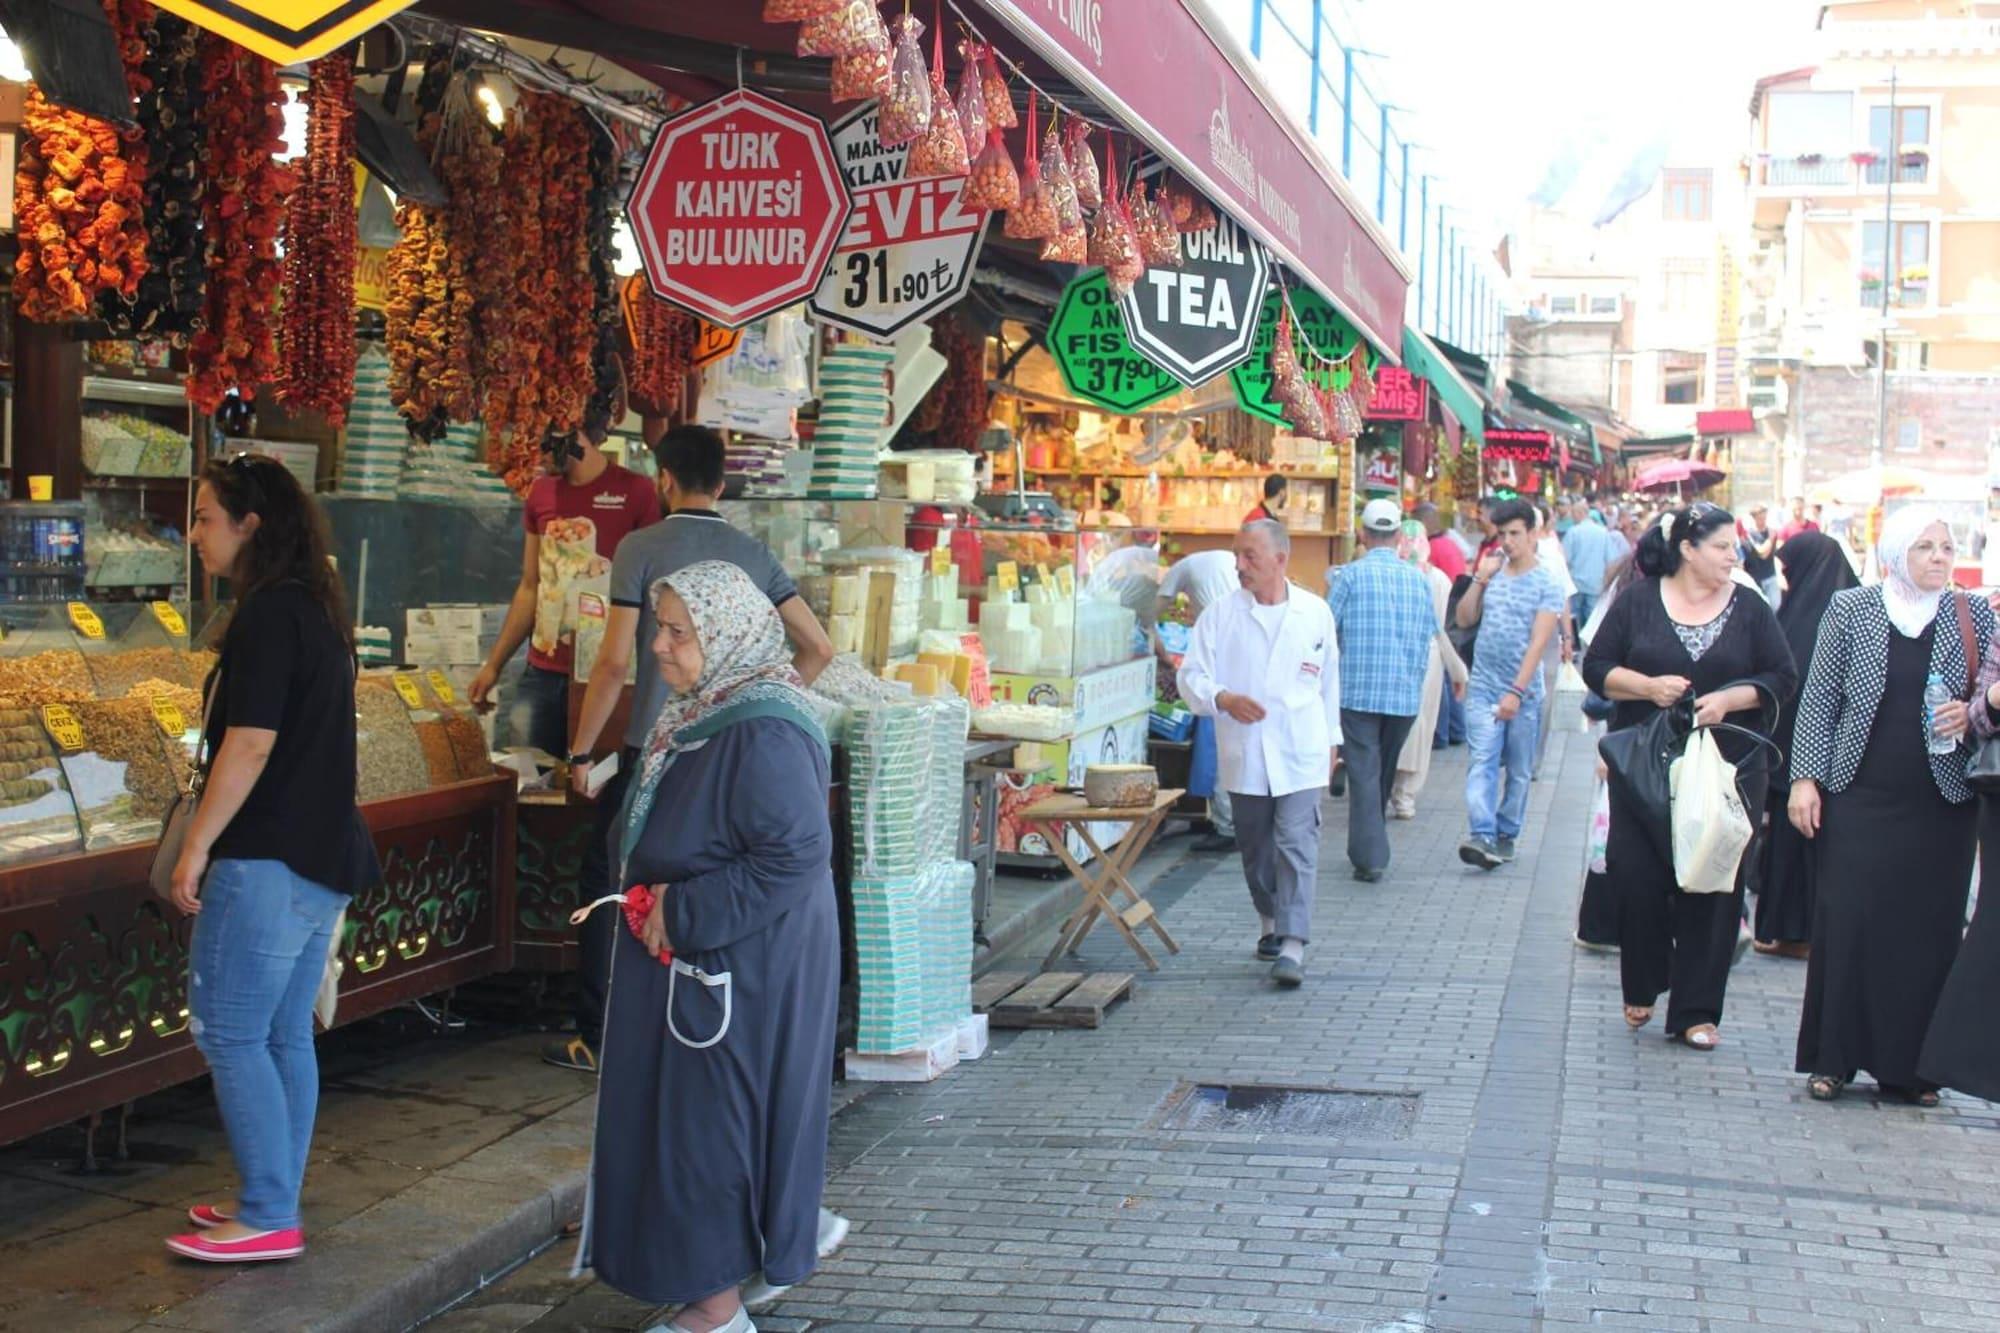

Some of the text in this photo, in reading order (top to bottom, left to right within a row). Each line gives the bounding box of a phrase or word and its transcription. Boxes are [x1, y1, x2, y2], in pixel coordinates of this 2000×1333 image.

[701, 123, 780, 170] TÜRK
[675, 169, 803, 218] KAHVESİ
[666, 227, 807, 266] BULUNUR
[1177, 212, 1245, 266] URAL
[1148, 268, 1238, 331] TEA
[1067, 332, 1128, 354] FIS
[1376, 367, 1413, 392] ER
